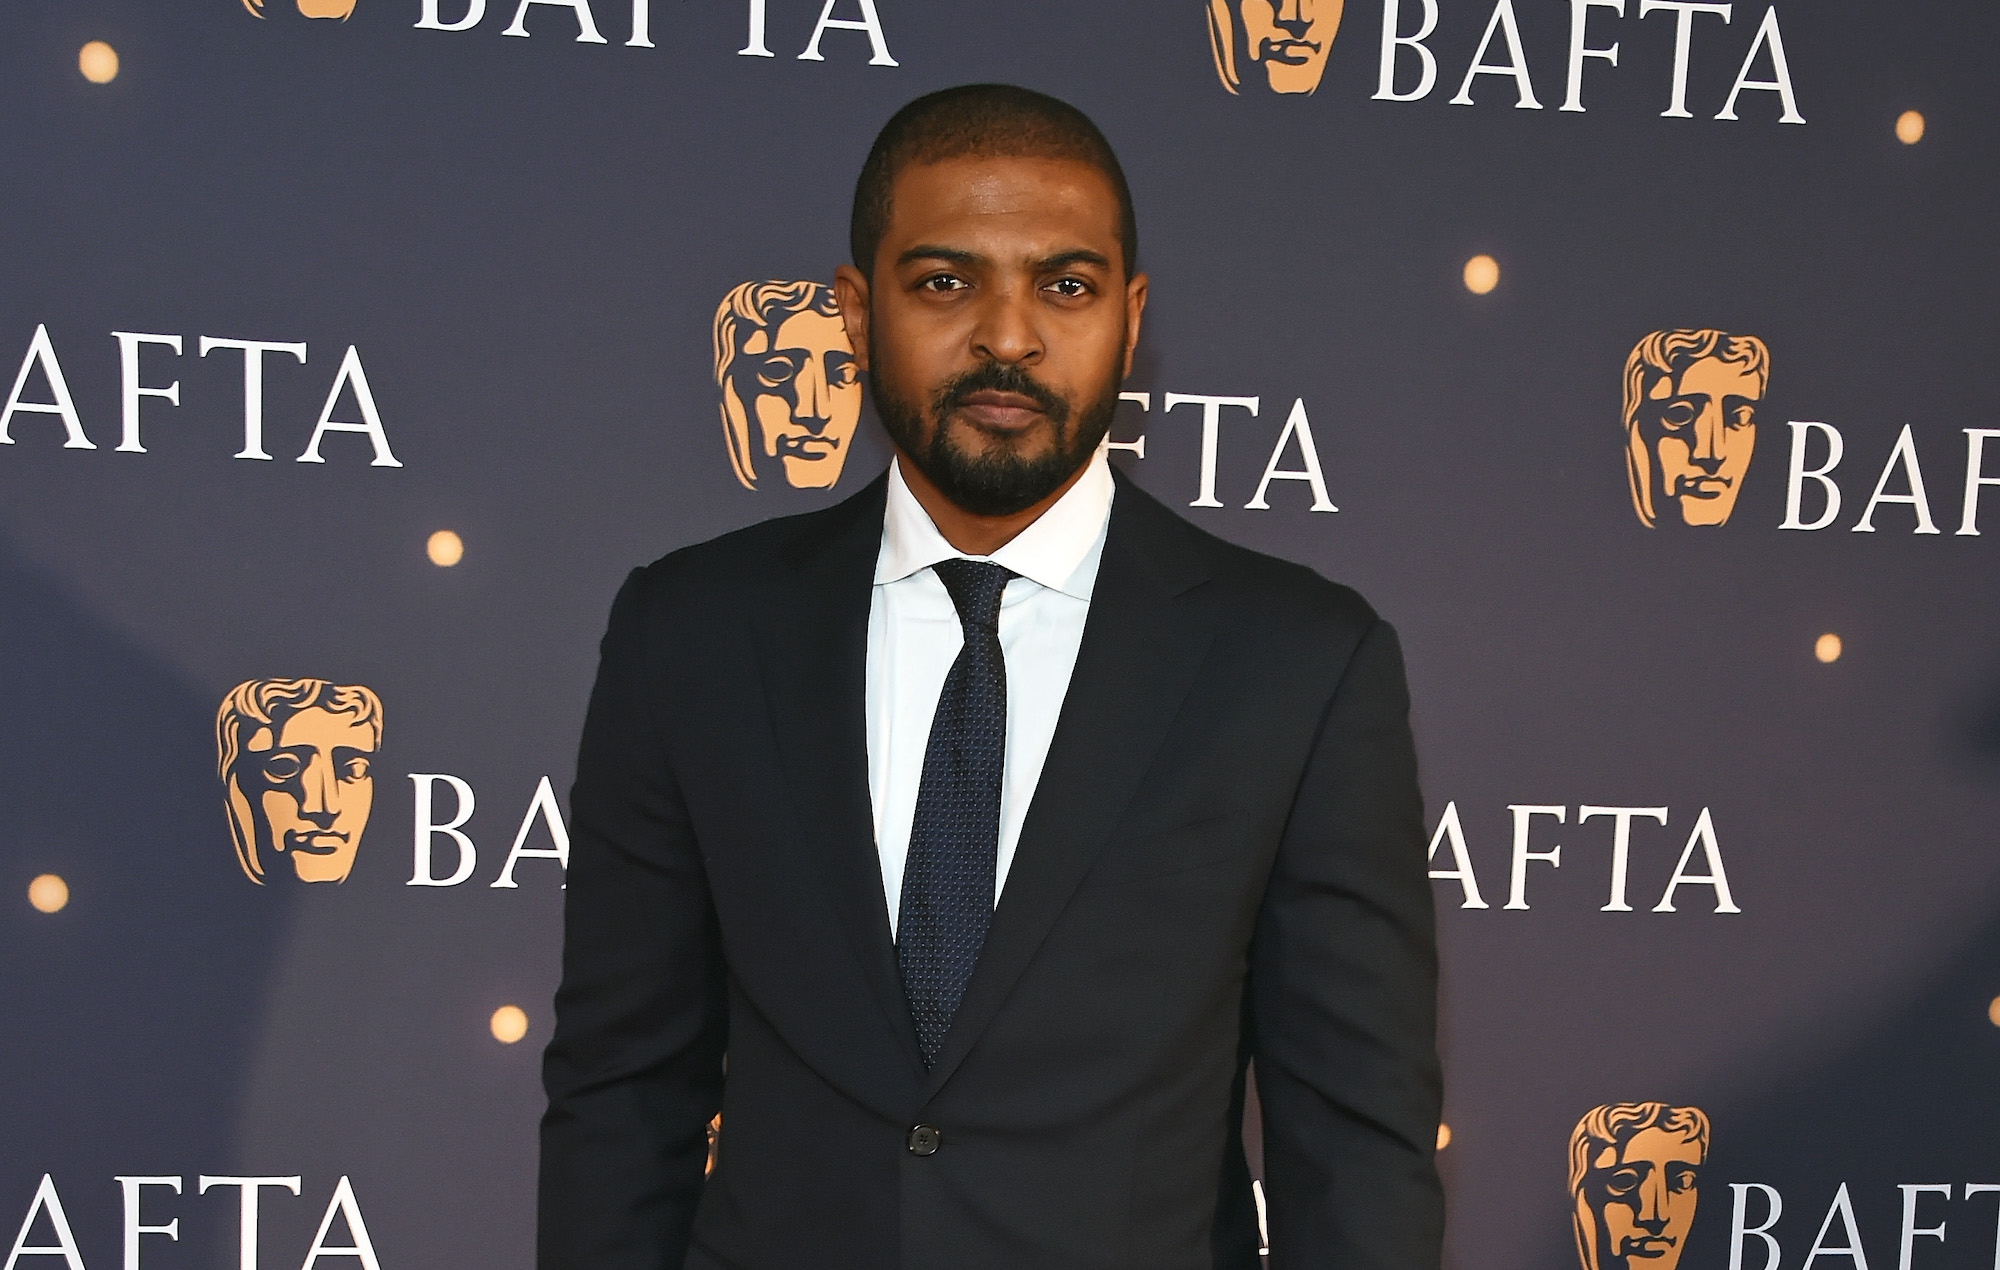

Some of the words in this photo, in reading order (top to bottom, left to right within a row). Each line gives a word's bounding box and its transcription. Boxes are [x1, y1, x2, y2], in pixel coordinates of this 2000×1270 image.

[1370, 0, 1807, 125] BAFTA
[0, 324, 404, 468] AFTA
[405, 773, 570, 890] BA
[1427, 800, 1742, 914] AFTA
[3, 1172, 382, 1270] AFTA
